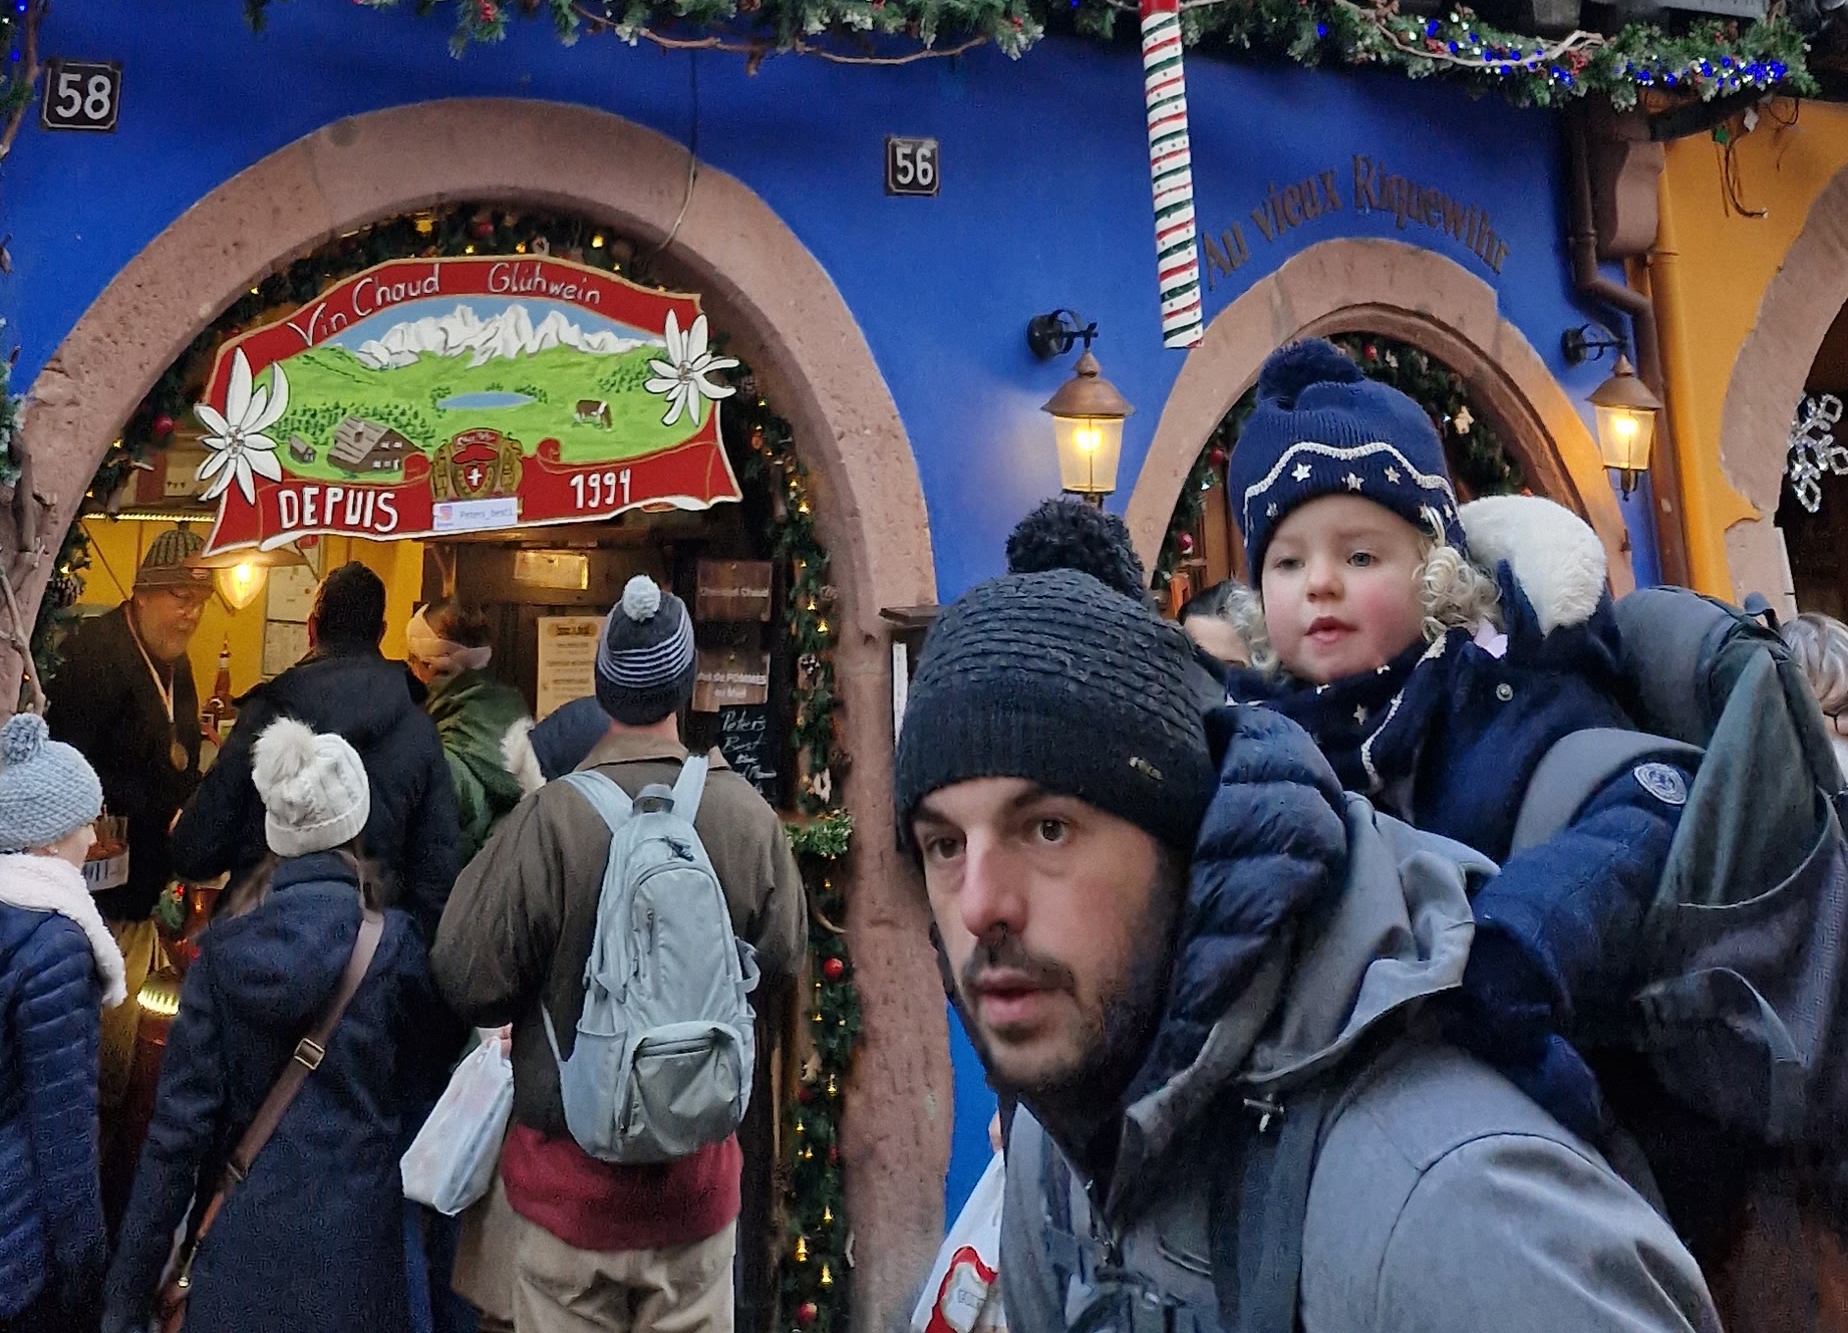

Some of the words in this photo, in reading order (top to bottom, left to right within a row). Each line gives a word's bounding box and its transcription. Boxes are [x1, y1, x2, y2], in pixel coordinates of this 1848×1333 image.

[55, 73, 112, 120] 58
[896, 145, 934, 186] 56
[1202, 221, 1250, 292] Au
[1250, 168, 1343, 243] vieux
[1351, 154, 1511, 275] Riquewihr
[286, 302, 348, 348] Vin
[352, 263, 440, 317] Chaud
[277, 486, 400, 531] DEPUIS
[569, 467, 632, 509] 1994
